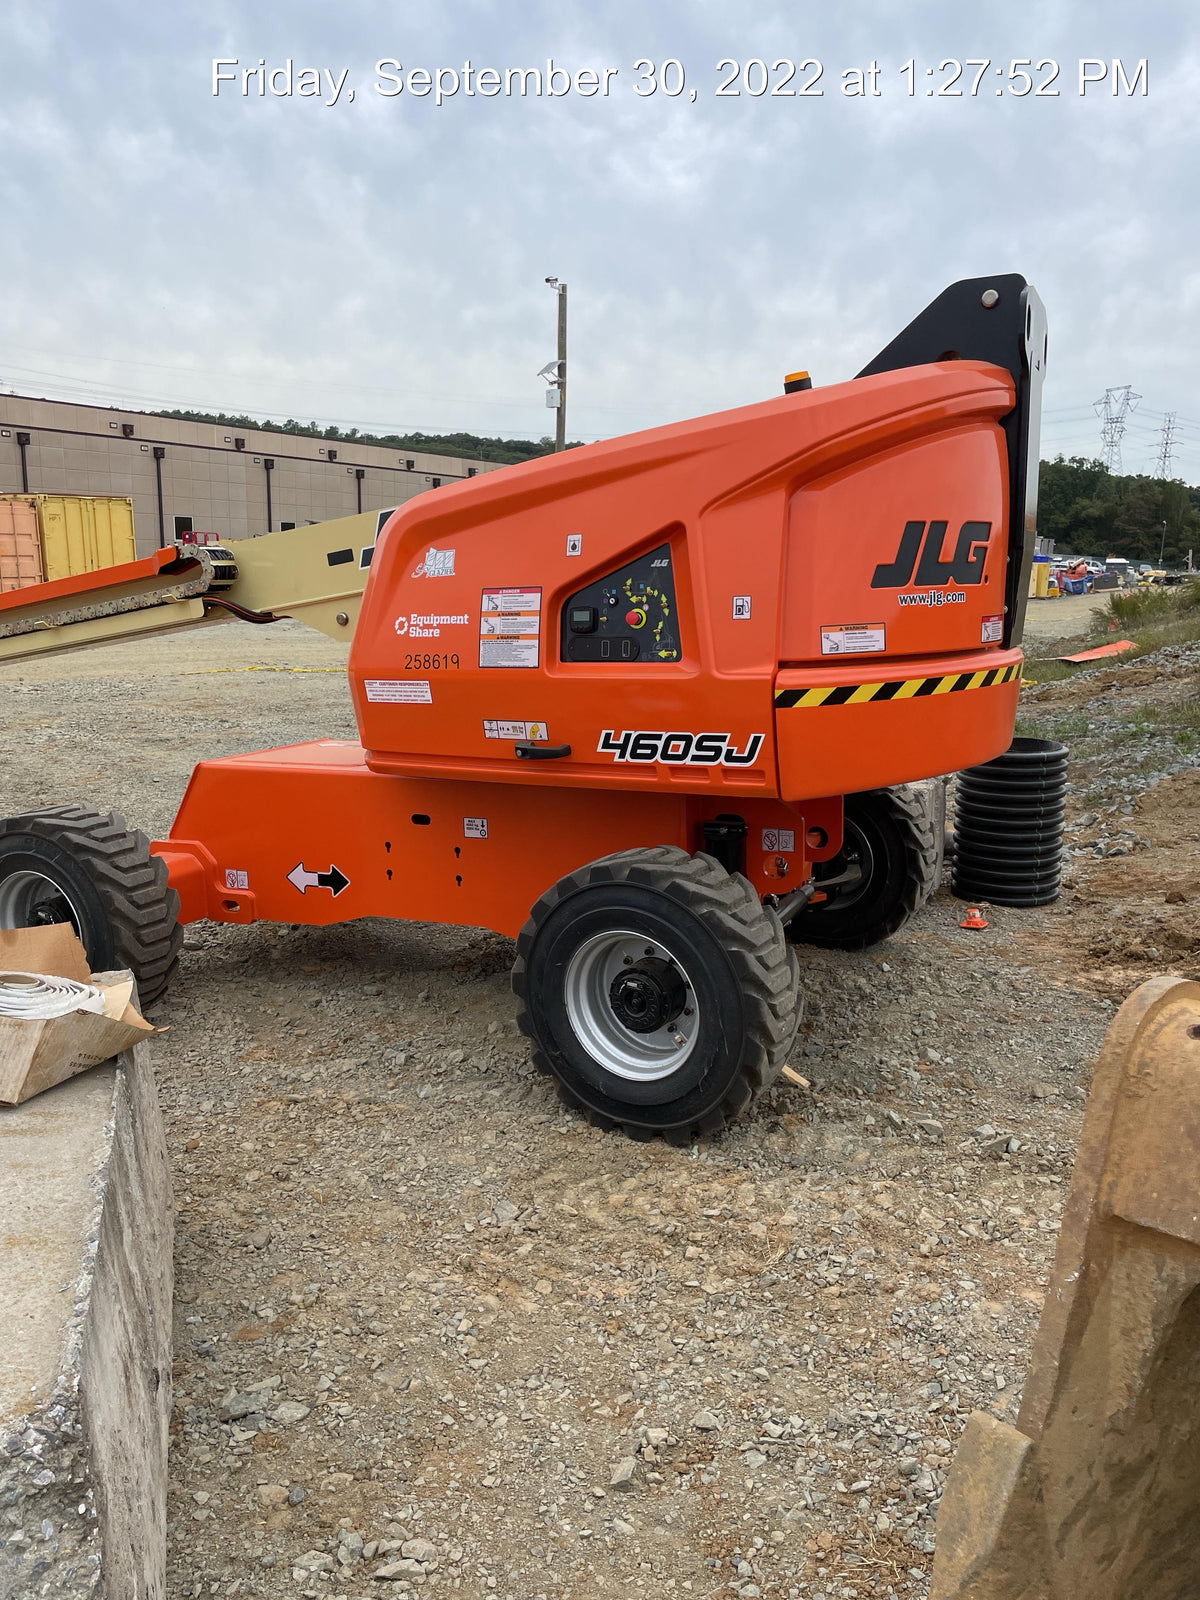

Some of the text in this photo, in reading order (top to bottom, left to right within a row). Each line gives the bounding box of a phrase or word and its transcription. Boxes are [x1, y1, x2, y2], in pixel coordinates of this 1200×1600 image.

[870, 520, 993, 589] JLG
[650, 559, 670, 568] JLG
[898, 590, 966, 607] www.jlg.com
[410, 613, 469, 627] Equipment
[408, 626, 440, 637] Share
[404, 653, 460, 670] 258619
[597, 729, 766, 768] 460SJ
